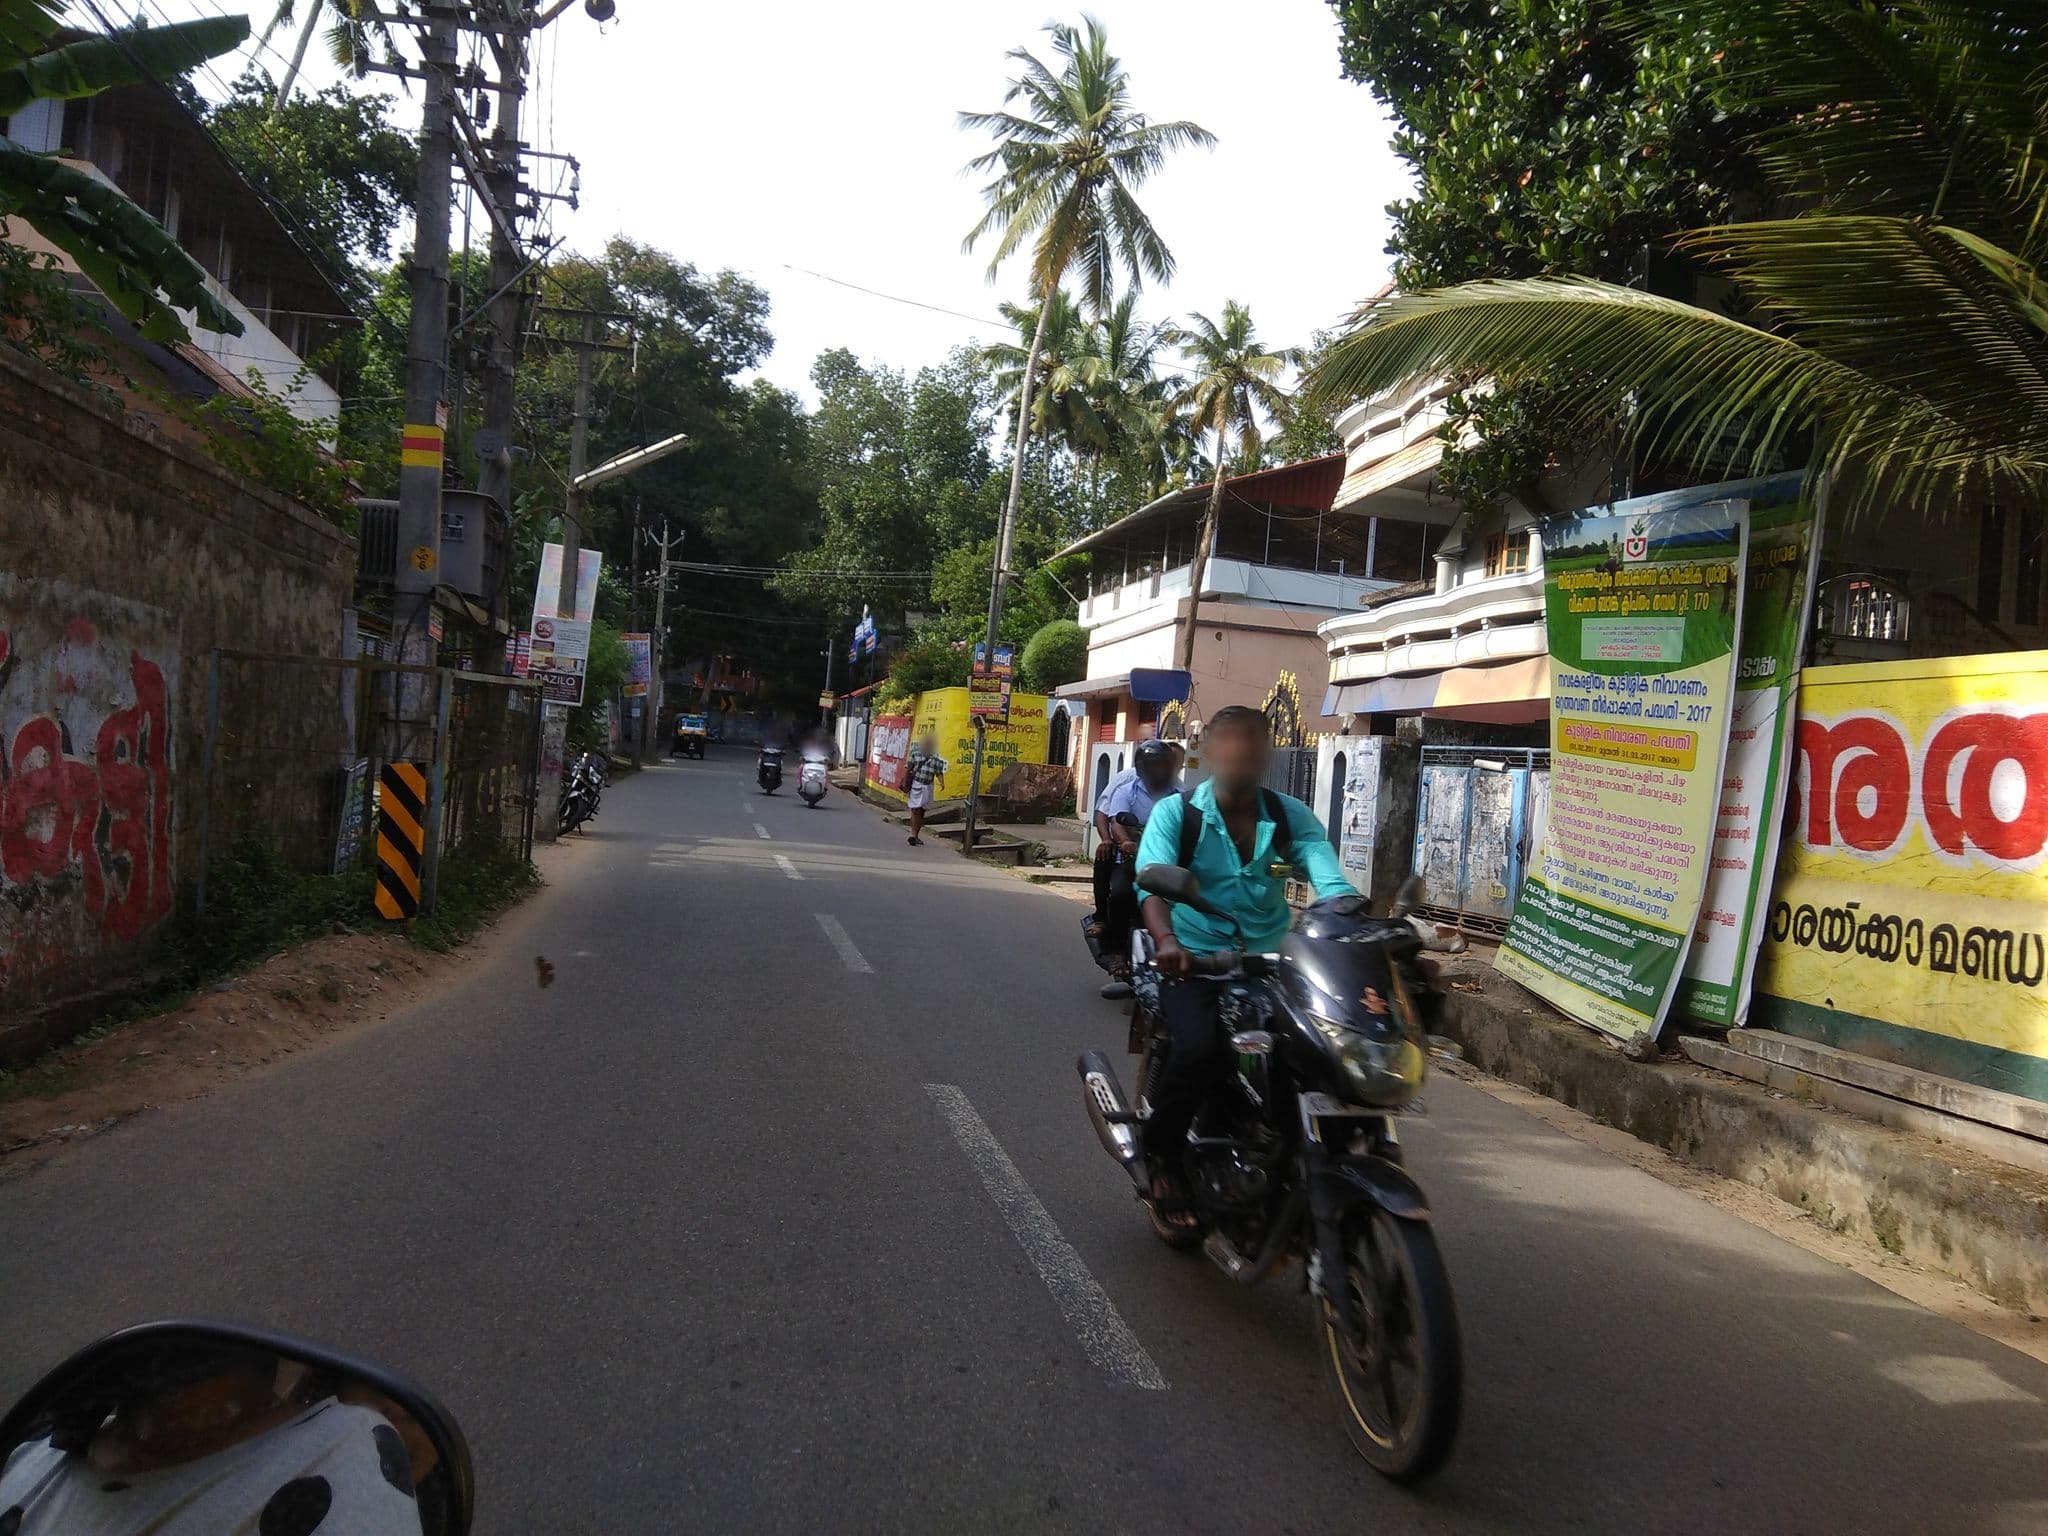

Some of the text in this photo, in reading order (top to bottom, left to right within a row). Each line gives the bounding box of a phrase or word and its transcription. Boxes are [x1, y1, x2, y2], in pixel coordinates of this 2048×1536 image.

[1706, 564, 1728, 588] ഗ്രാമ
[1694, 592, 1710, 611] 170
[1652, 674, 1708, 696] നിവാരണം
[1604, 727, 1648, 744] നിവാരണ
[1650, 734, 1691, 750] പദ്ധതി
